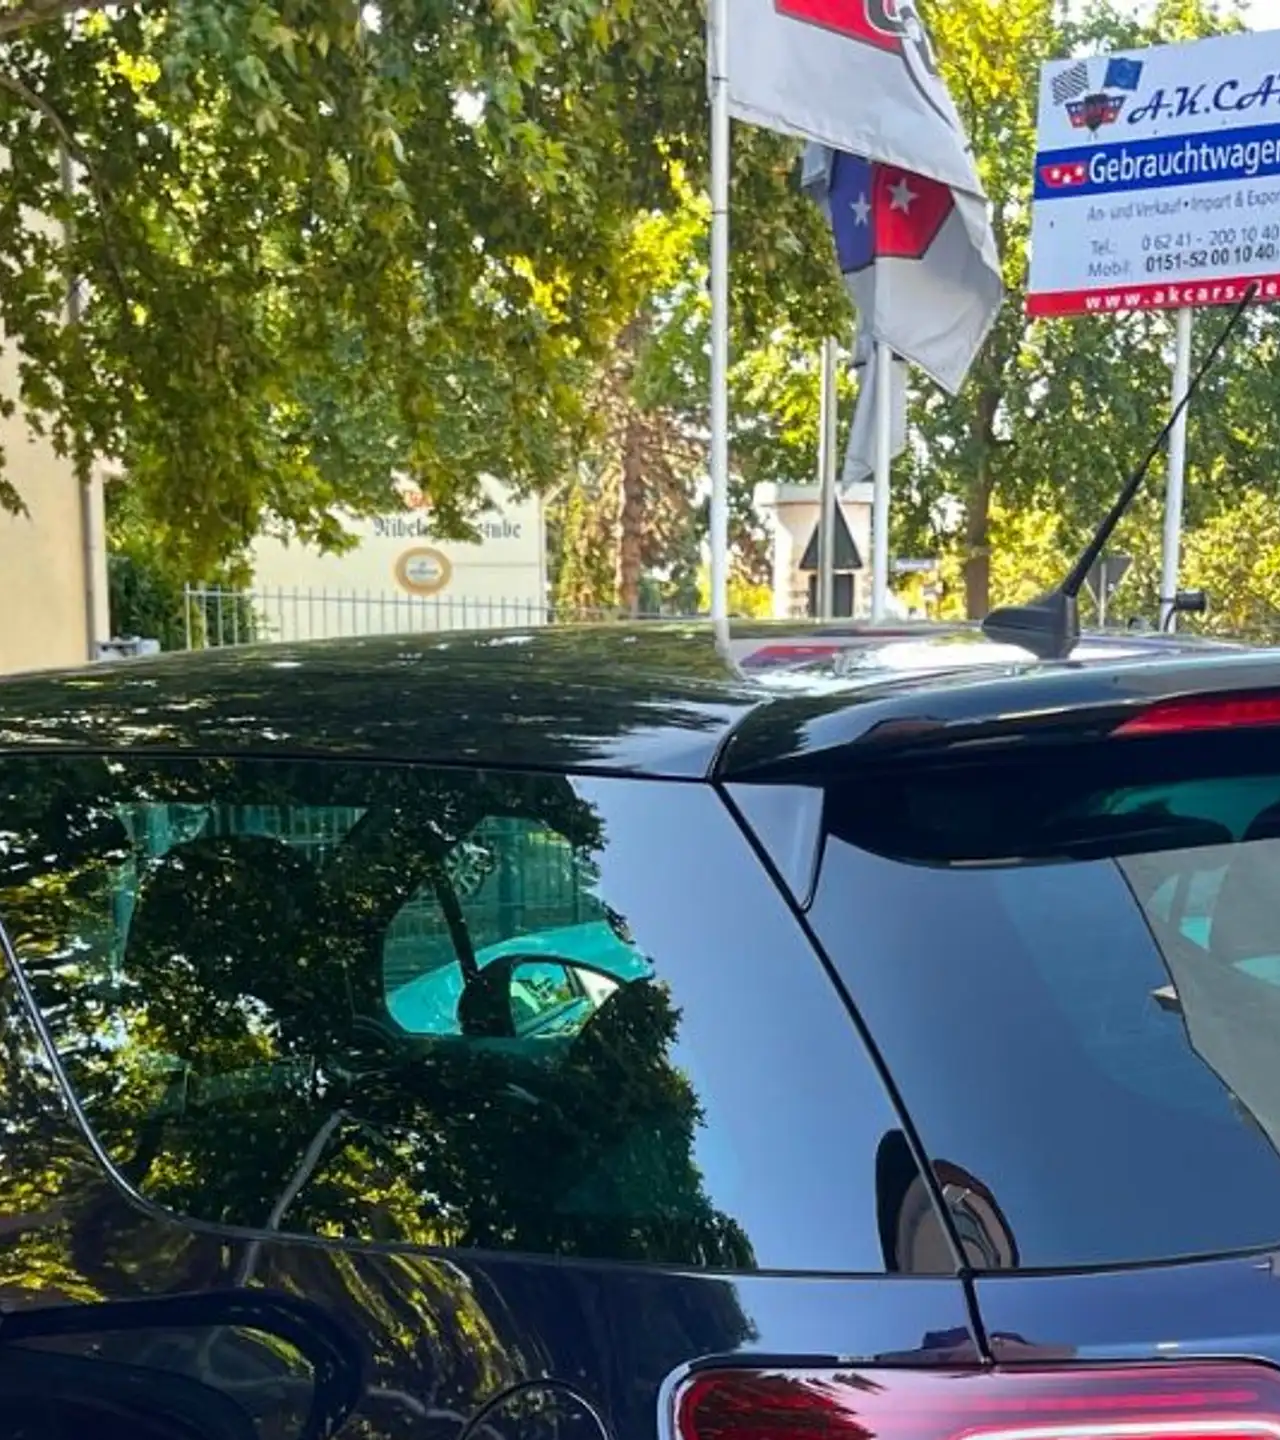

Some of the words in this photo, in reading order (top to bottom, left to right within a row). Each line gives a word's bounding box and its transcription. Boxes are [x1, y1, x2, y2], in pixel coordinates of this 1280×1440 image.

[1110, 202, 1134, 220] und
[1135, 196, 1182, 217] Verkauf
[1190, 192, 1232, 214] Import
[1233, 189, 1244, 208] &
[1141, 233, 1152, 251] 0
[1153, 232, 1172, 251] 62
[1174, 231, 1192, 248] 41
[1208, 227, 1237, 247] 200
[1240, 224, 1258, 243] 10
[1261, 222, 1280, 242] 40
[1145, 249, 1208, 273] 0151-52
[1210, 246, 1230, 266] 00
[1233, 244, 1253, 264] 10
[1254, 242, 1276, 260] 40
